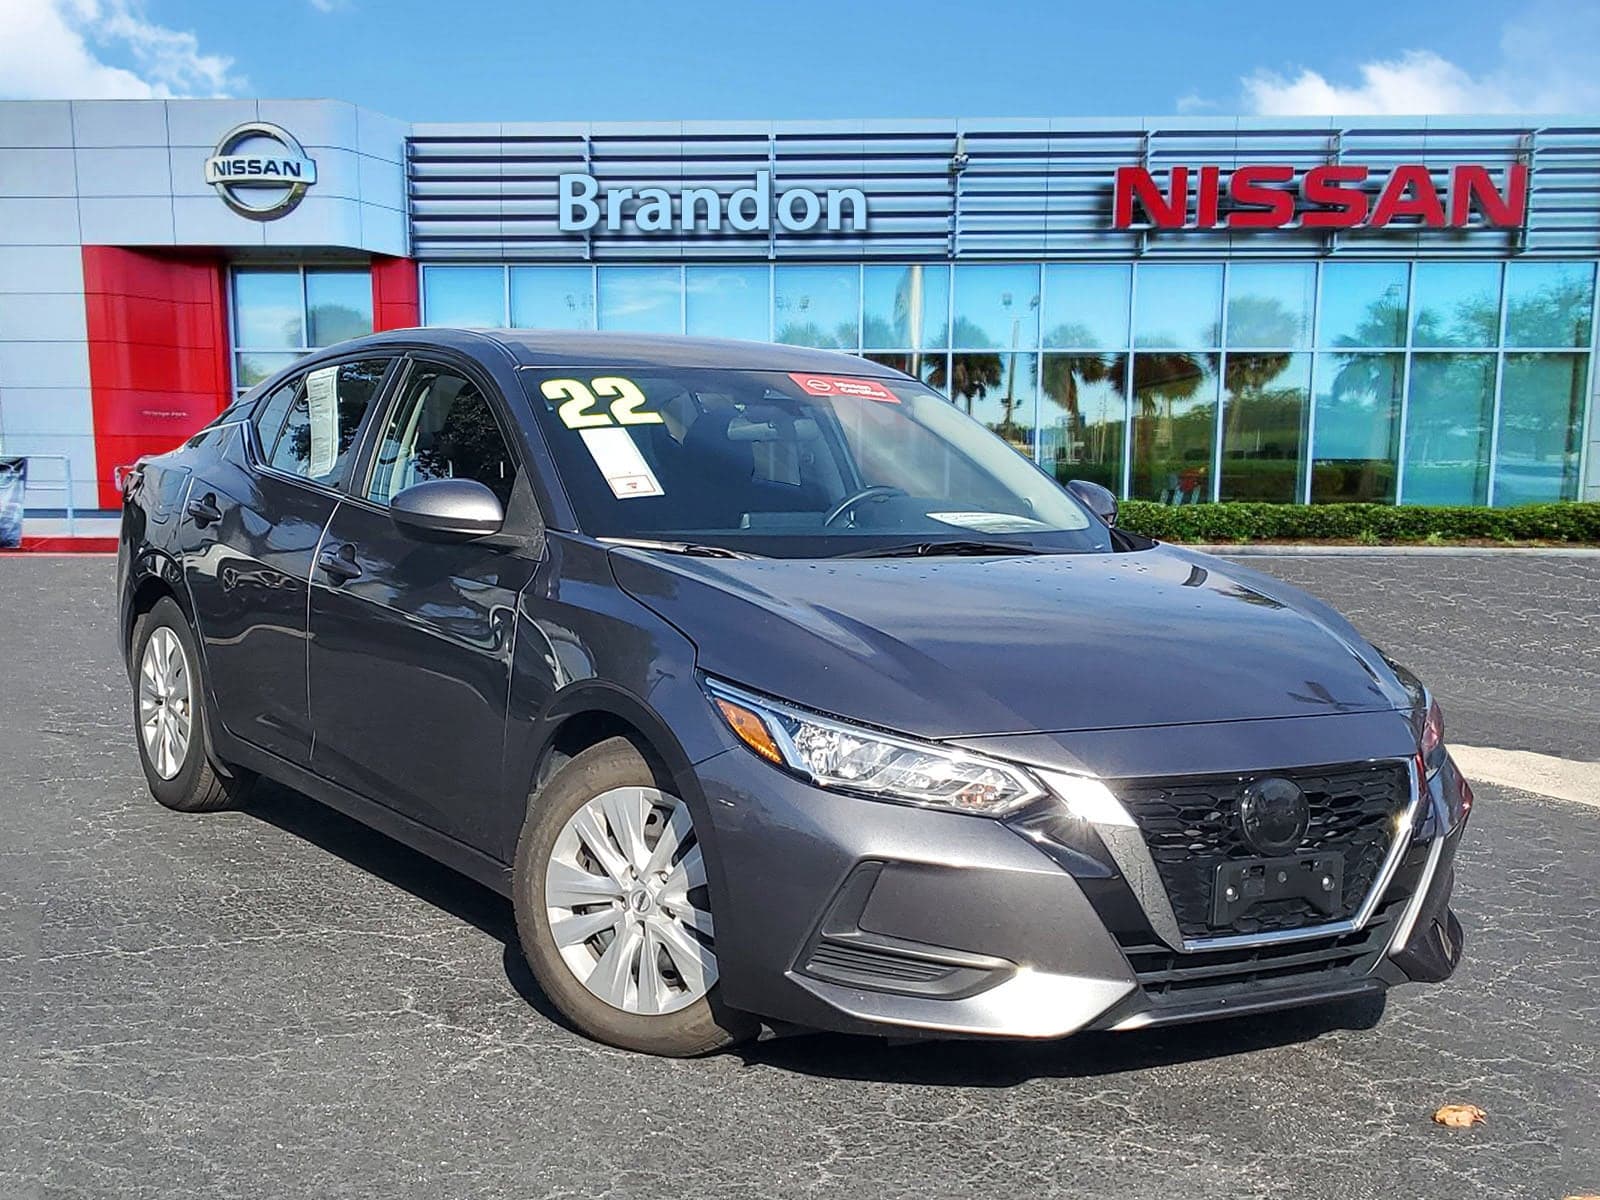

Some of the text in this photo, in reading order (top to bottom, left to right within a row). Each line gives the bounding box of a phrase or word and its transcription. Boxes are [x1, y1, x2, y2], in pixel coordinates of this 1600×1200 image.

[213, 159, 301, 177] NISSAN
[1114, 165, 1529, 228] NISSAN
[559, 170, 867, 231] Brandon
[540, 376, 665, 430] 22
